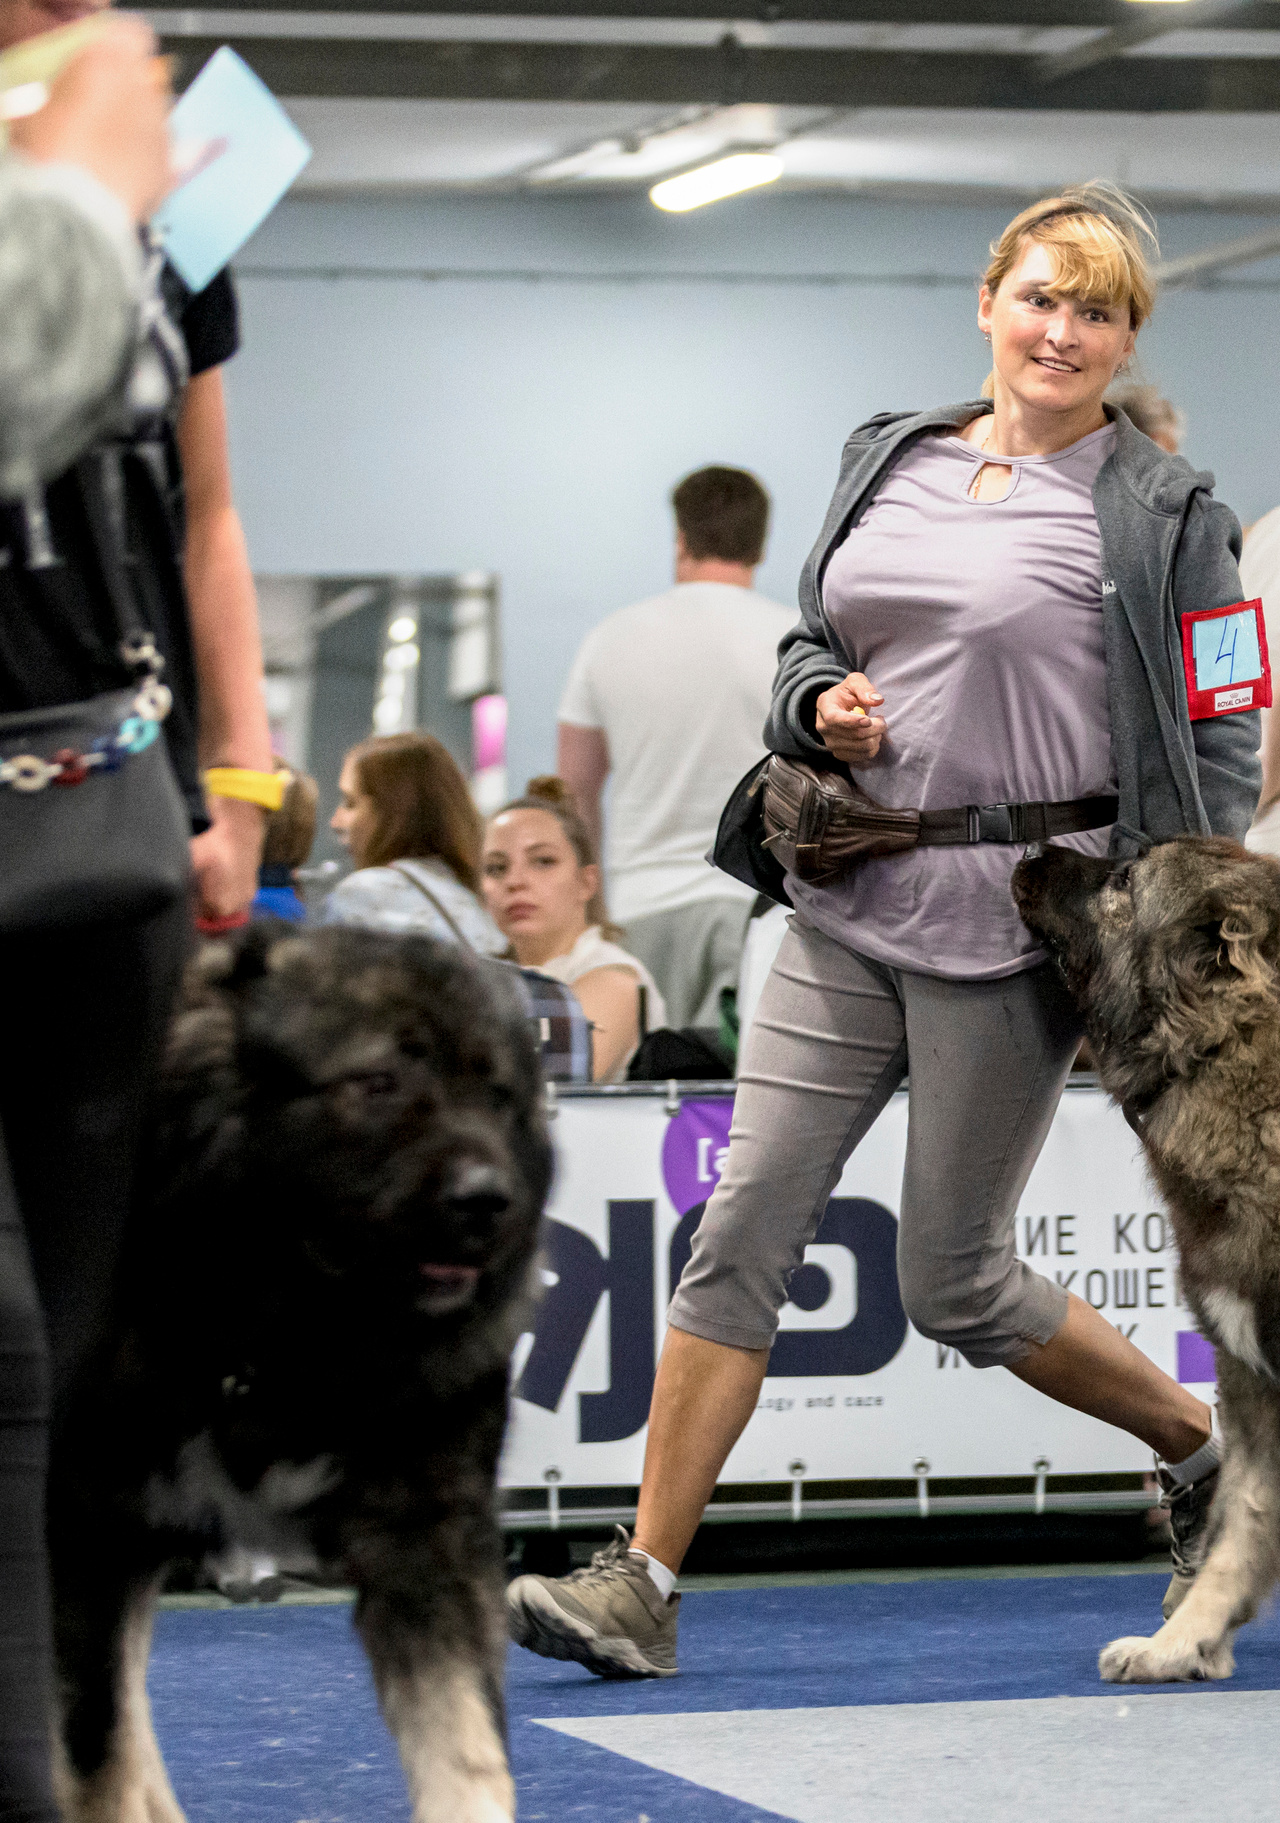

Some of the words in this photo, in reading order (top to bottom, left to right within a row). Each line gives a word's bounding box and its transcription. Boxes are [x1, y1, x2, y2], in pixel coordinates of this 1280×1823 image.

[1215, 617, 1237, 685] 4
[1217, 700, 1234, 708] ROYAL
[1234, 696, 1251, 705] CANIN
[1015, 1214, 1078, 1257] ИЕ
[1056, 1267, 1182, 1310] КОШЕ
[806, 1394, 835, 1408] and
